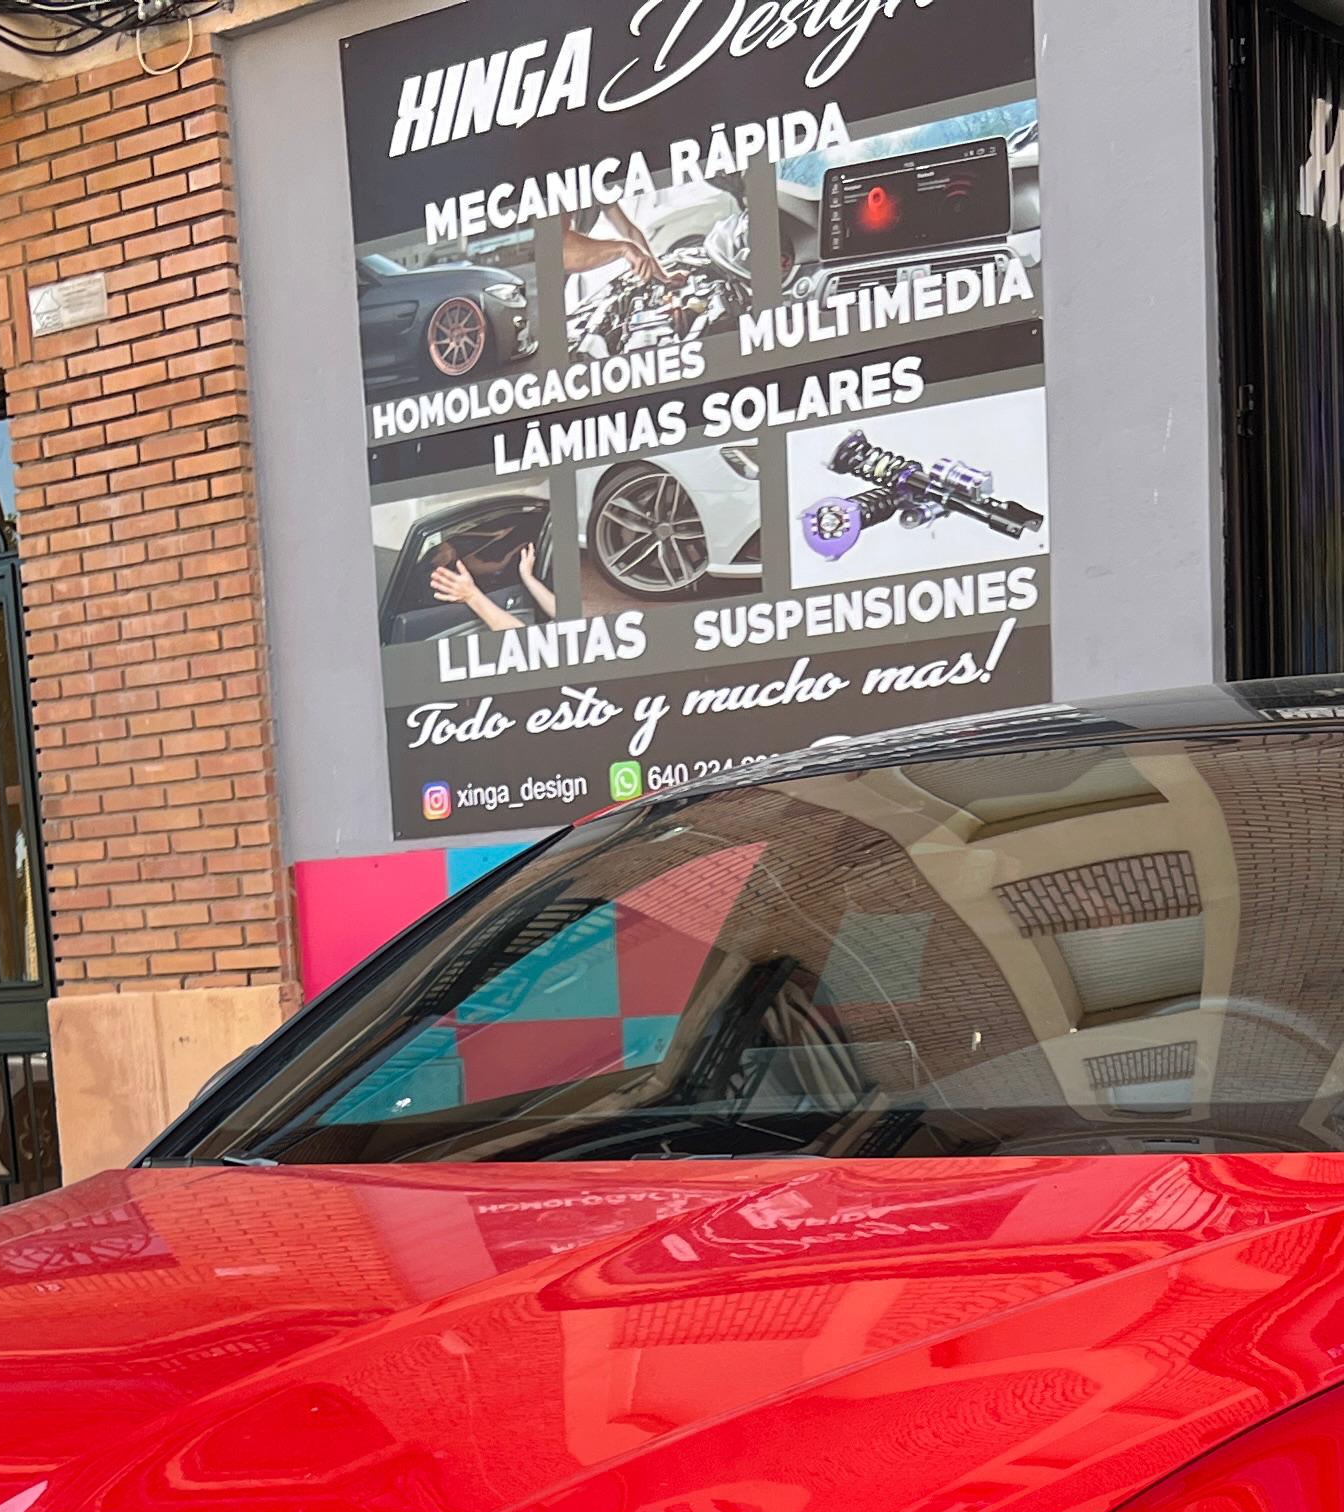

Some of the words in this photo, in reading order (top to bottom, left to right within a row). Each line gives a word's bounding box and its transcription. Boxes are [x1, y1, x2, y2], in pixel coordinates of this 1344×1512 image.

[424, 151, 656, 245] MECANICA
[669, 102, 851, 185] RÁPIDA
[372, 341, 706, 439] HOMOLOGACIONES
[493, 400, 687, 476] LÁMINAS
[702, 355, 926, 438] SOLARES
[436, 610, 648, 683] LLANTAS
[693, 566, 1038, 651] SUSPENSIONES
[406, 696, 517, 749] Todo
[526, 686, 624, 734] esto
[628, 694, 671, 757] y
[681, 657, 850, 716] mucho
[861, 617, 1017, 695] mas!
[456, 774, 588, 811] xinga_design
[647, 763, 689, 790] 640
